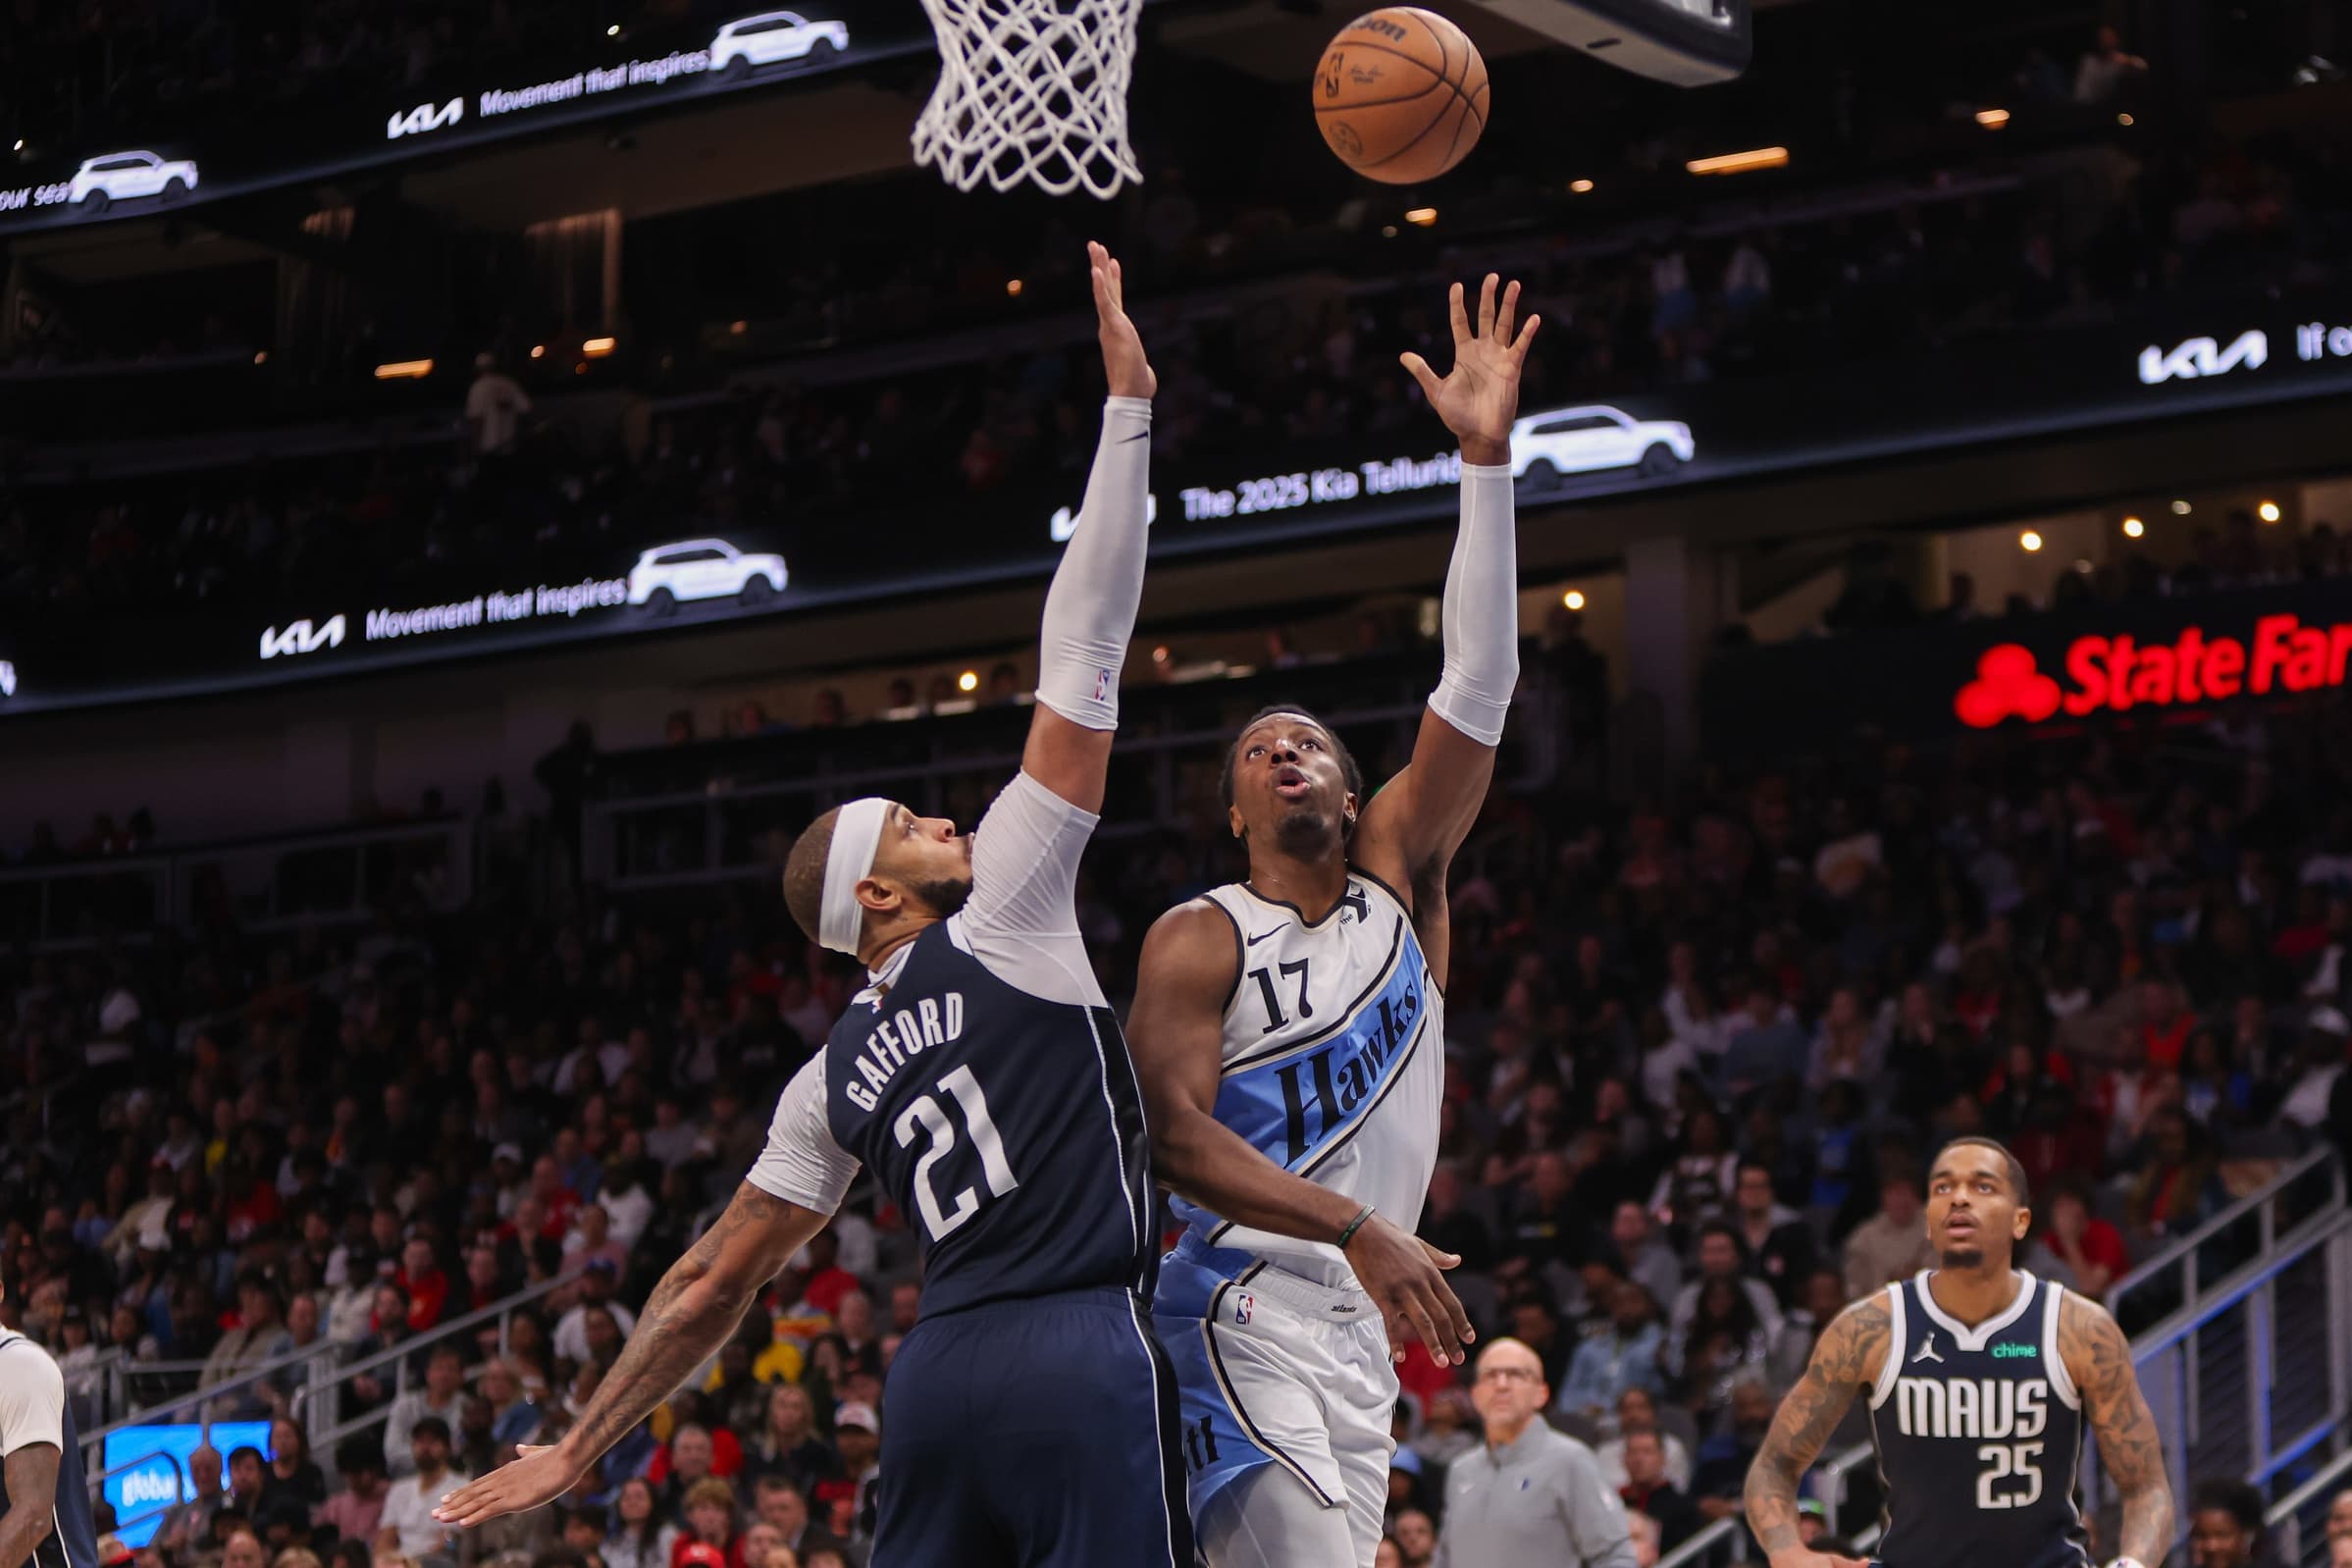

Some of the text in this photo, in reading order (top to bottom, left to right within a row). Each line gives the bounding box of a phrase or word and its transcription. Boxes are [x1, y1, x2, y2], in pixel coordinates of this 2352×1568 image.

[480, 73, 583, 118] Movement
[585, 64, 627, 95] that
[628, 51, 710, 85] inspires
[2296, 321, 2326, 361] If
[2327, 325, 2352, 357] o
[1179, 486, 1236, 521] The
[1236, 472, 1309, 515] 2025
[1310, 467, 1358, 502] Kia
[1359, 448, 1461, 496] Tellurid
[365, 595, 484, 642] Movement
[486, 587, 534, 623] that
[535, 577, 628, 618] inspires
[2064, 611, 2352, 716] State Far
[1247, 957, 1314, 1035] 17
[846, 992, 965, 1112] GAFFORD
[1273, 980, 1417, 1171] Hawks
[893, 1064, 1019, 1242] 21
[1992, 1341, 2038, 1358] chime
[122, 1468, 177, 1506] globa
[1976, 1440, 2046, 1509] 25
